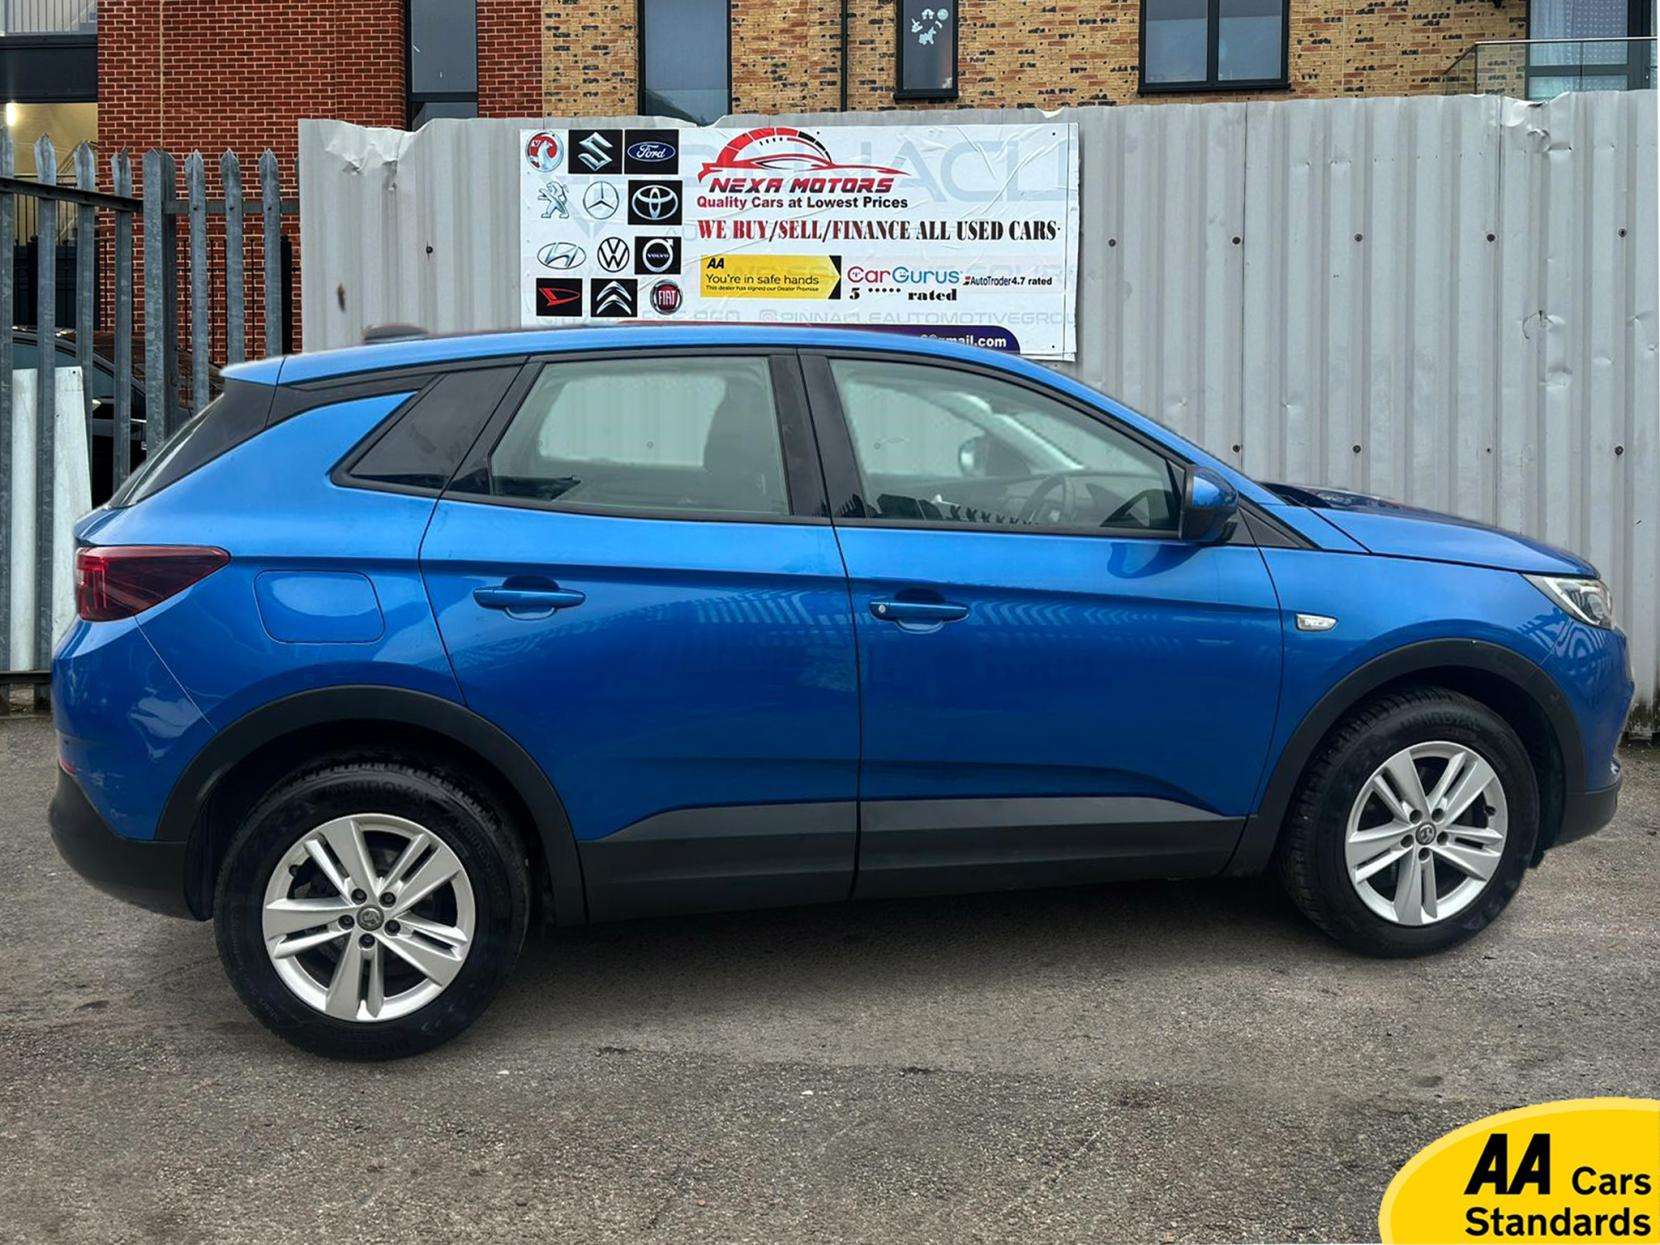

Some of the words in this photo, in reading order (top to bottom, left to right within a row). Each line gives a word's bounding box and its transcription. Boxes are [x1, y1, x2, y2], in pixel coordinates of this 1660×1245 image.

[636, 144, 666, 159] Ford
[709, 178, 784, 193] NEXA
[789, 177, 895, 193] MOTORS
[696, 195, 747, 211] Quality
[751, 196, 784, 208] Cars
[788, 196, 803, 208] at
[807, 196, 859, 208] Lowest
[863, 196, 909, 208] Prices
[698, 220, 727, 240] WE
[733, 220, 911, 243] BUY/SELL/FINANCE
[916, 220, 951, 241] ALL
[956, 220, 1004, 241] USED
[706, 257, 725, 269] AA
[706, 274, 741, 284] You're
[744, 274, 754, 284] in
[757, 274, 781, 285] safe
[784, 275, 820, 285] hands
[847, 266, 961, 284] CarGurus
[1027, 277, 1053, 285] rated
[658, 290, 677, 305] FIAT
[849, 287, 860, 300] 5
[908, 288, 957, 301] rated
